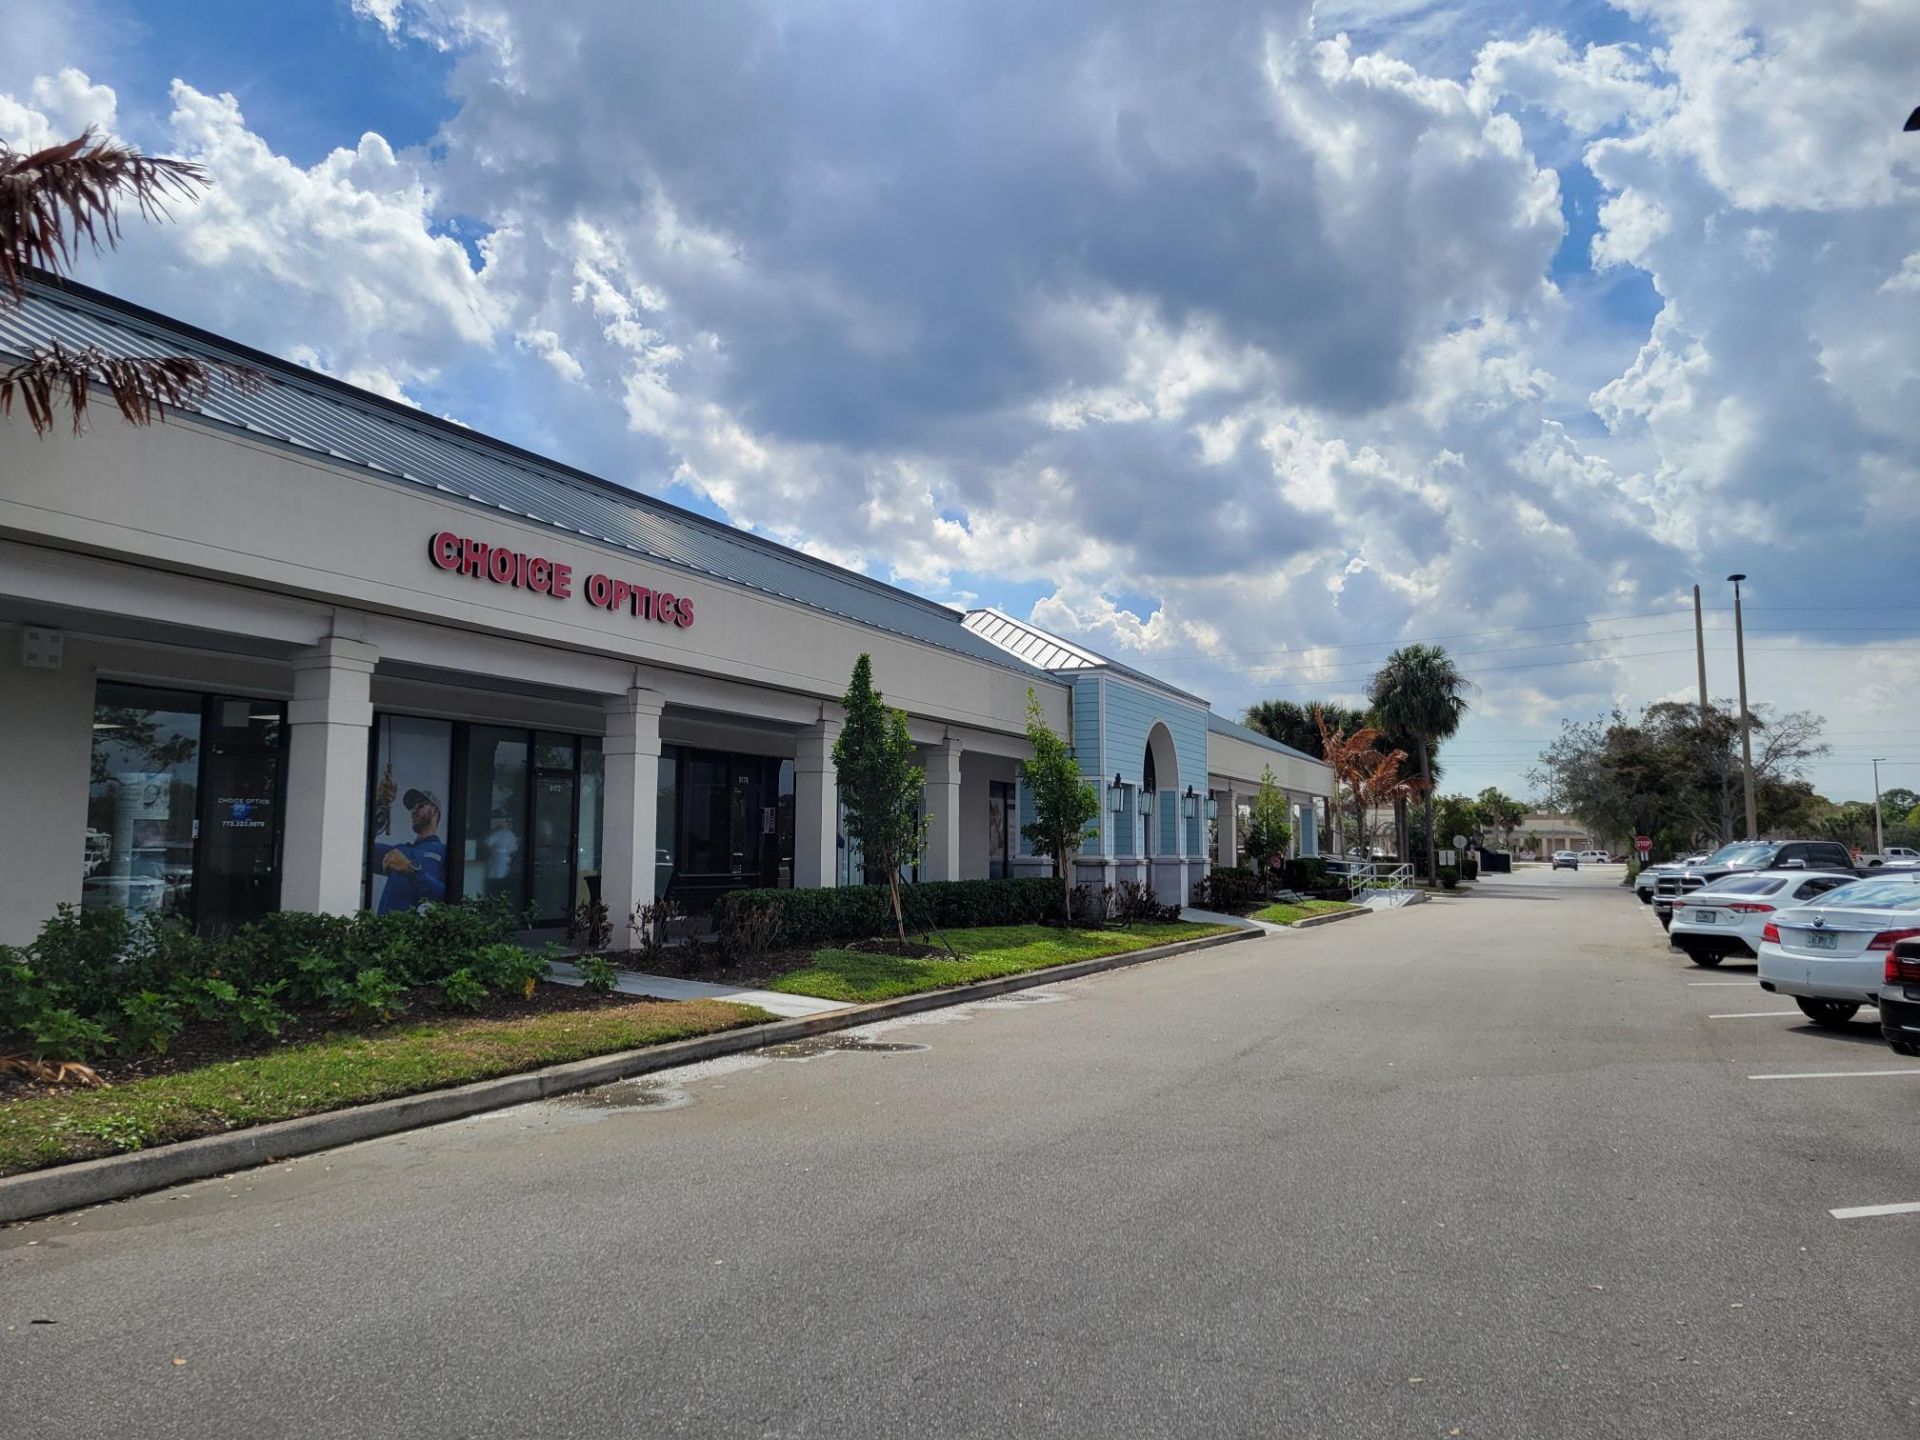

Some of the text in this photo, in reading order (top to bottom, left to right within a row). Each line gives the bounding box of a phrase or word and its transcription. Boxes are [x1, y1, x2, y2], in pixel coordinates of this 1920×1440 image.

[429, 531, 695, 629] CHOICE OPTICS
[1636, 840, 1650, 848] STOP
